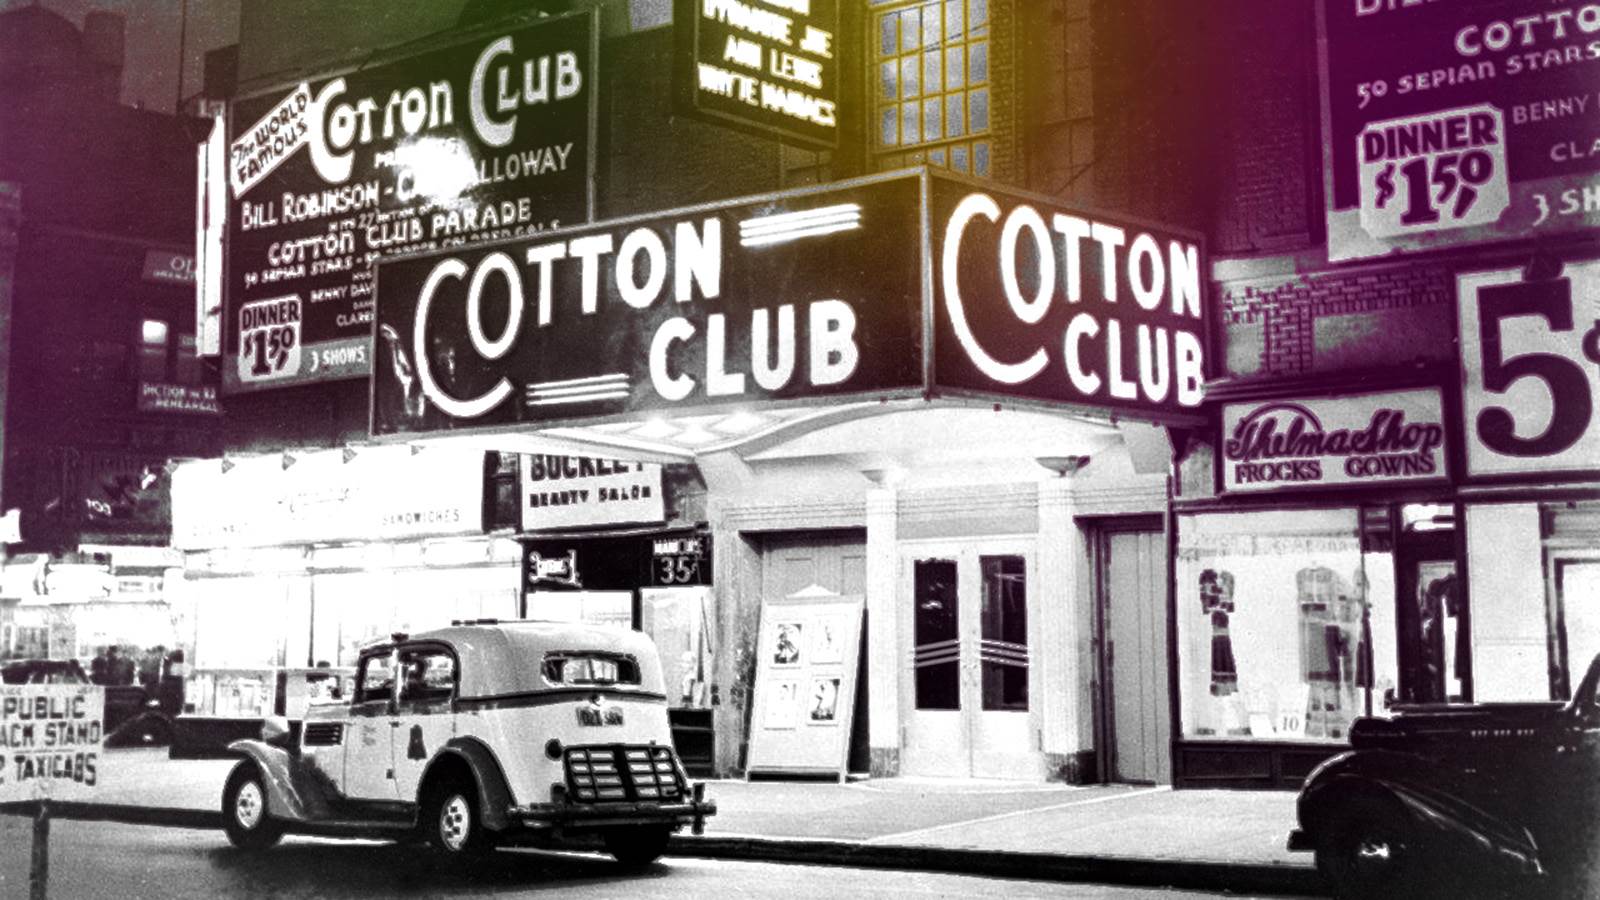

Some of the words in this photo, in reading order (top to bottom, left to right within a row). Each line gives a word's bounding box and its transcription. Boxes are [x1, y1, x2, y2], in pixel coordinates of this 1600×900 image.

[469, 35, 583, 147] CLUB
[1357, 80, 1389, 110] 50
[1397, 60, 1496, 94] SEPIAN
[1512, 94, 1589, 125] BENNY
[254, 91, 308, 148] WORLD
[1363, 111, 1499, 164] DINNER
[237, 118, 308, 185] FAMOUS
[241, 200, 279, 231] BILL
[282, 181, 379, 224] ROBINSON
[478, 142, 574, 185] LLOWAY
[267, 231, 355, 266] COTTON
[366, 217, 424, 249] CLUB
[432, 197, 532, 238] PARADE
[310, 255, 353, 277] STARS
[942, 192, 1201, 384] COTTON
[241, 299, 299, 331] DINNER
[310, 285, 349, 303] BENNY
[413, 216, 722, 419] COTTON
[322, 345, 366, 366] SHOWS
[648, 298, 860, 401] CLUB
[1063, 312, 1206, 407] CLUB
[1235, 459, 1323, 484] FROCKS
[1343, 452, 1437, 477] GOWNS
[530, 489, 590, 508] BEAUTY
[598, 484, 652, 502] SALON
[3, 695, 86, 720] PUBLIC
[45, 719, 101, 747] STAND
[14, 751, 98, 787] TAXICABS
